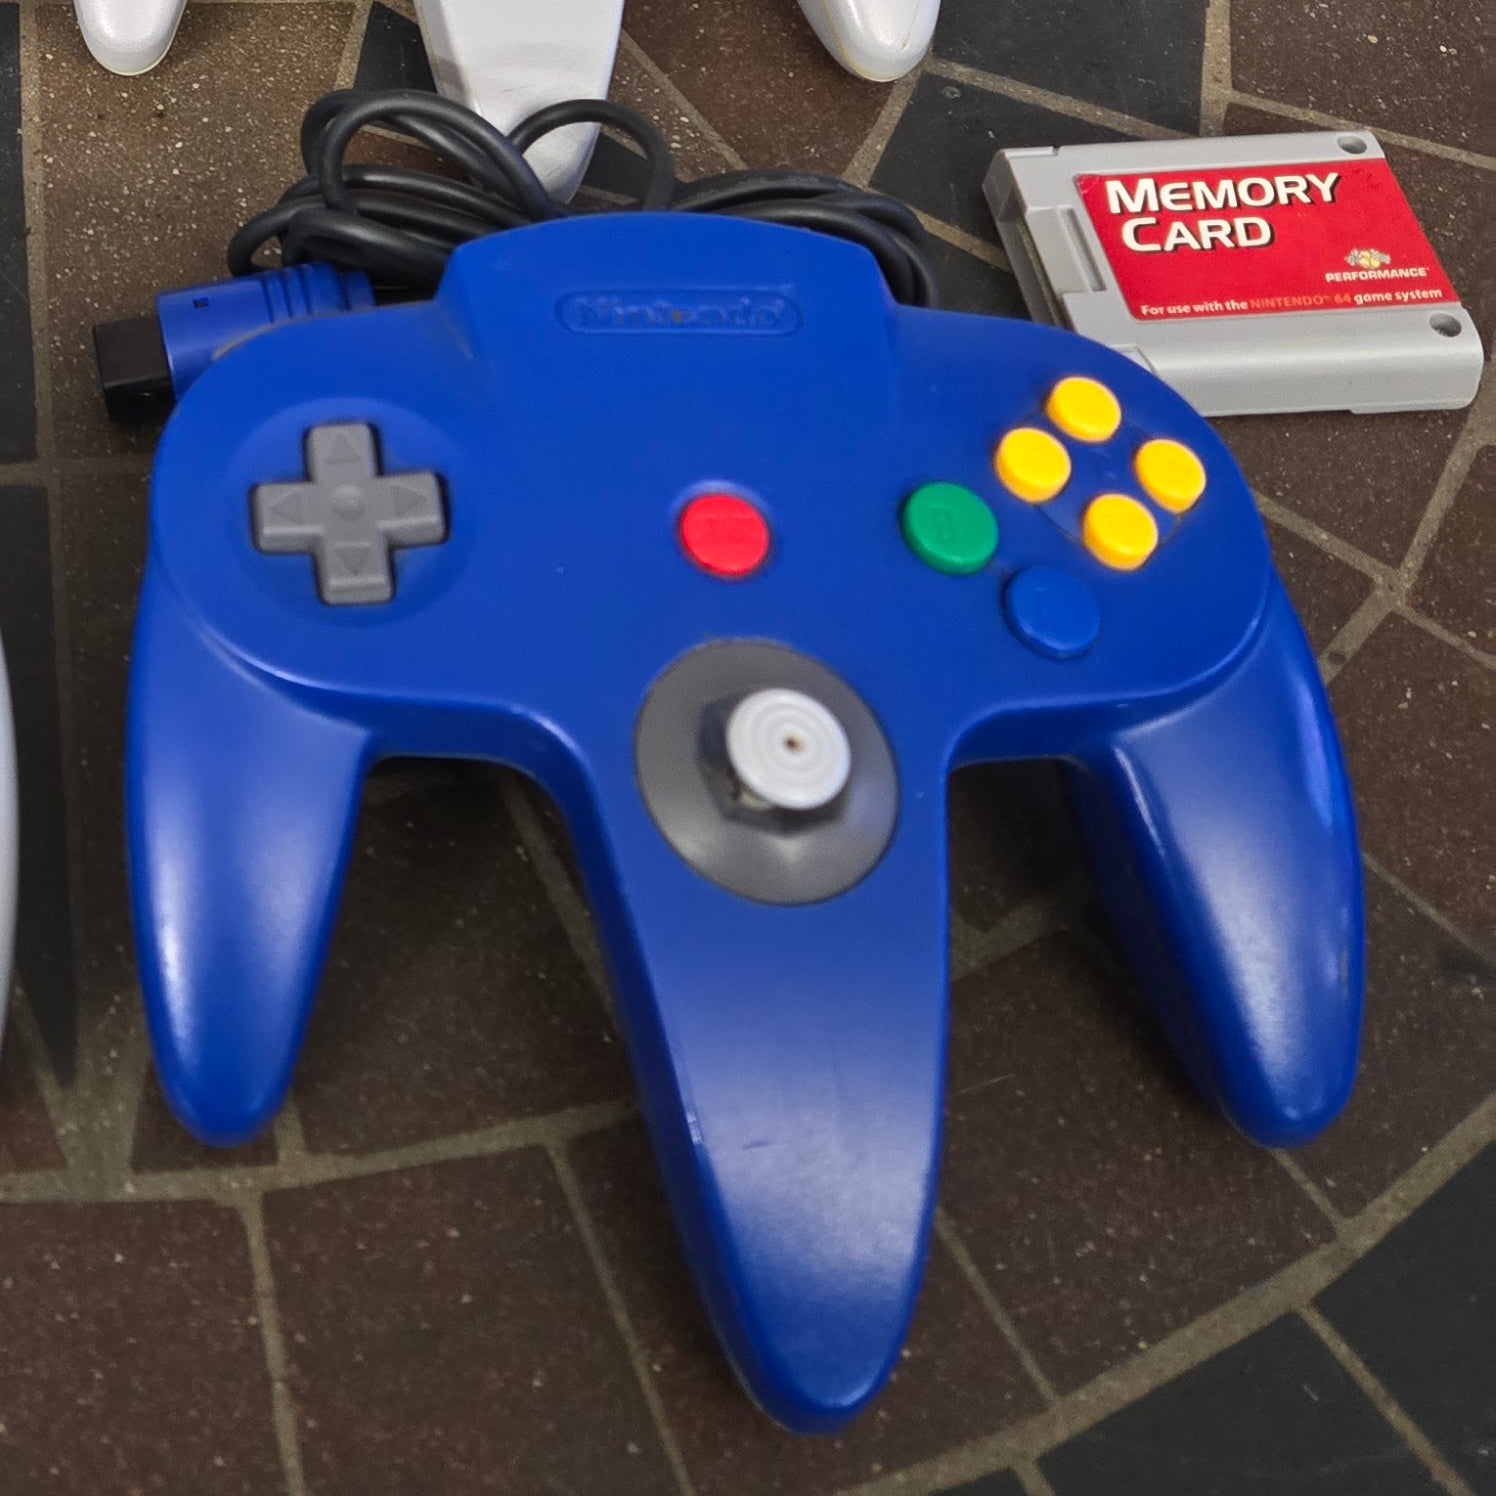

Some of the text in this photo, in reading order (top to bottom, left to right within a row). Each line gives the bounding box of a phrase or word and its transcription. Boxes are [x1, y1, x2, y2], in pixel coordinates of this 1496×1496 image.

[1105, 172, 1341, 215] MEMORY
[1121, 216, 1273, 252] CARD
[1325, 267, 1428, 283] PERFORMANCE
[1141, 304, 1165, 316] For
[1167, 305, 1191, 315] use
[1193, 300, 1223, 314] with
[1225, 299, 1248, 311] the
[1334, 293, 1351, 304] 64
[1353, 292, 1392, 307] game
[1395, 288, 1442, 303] system
